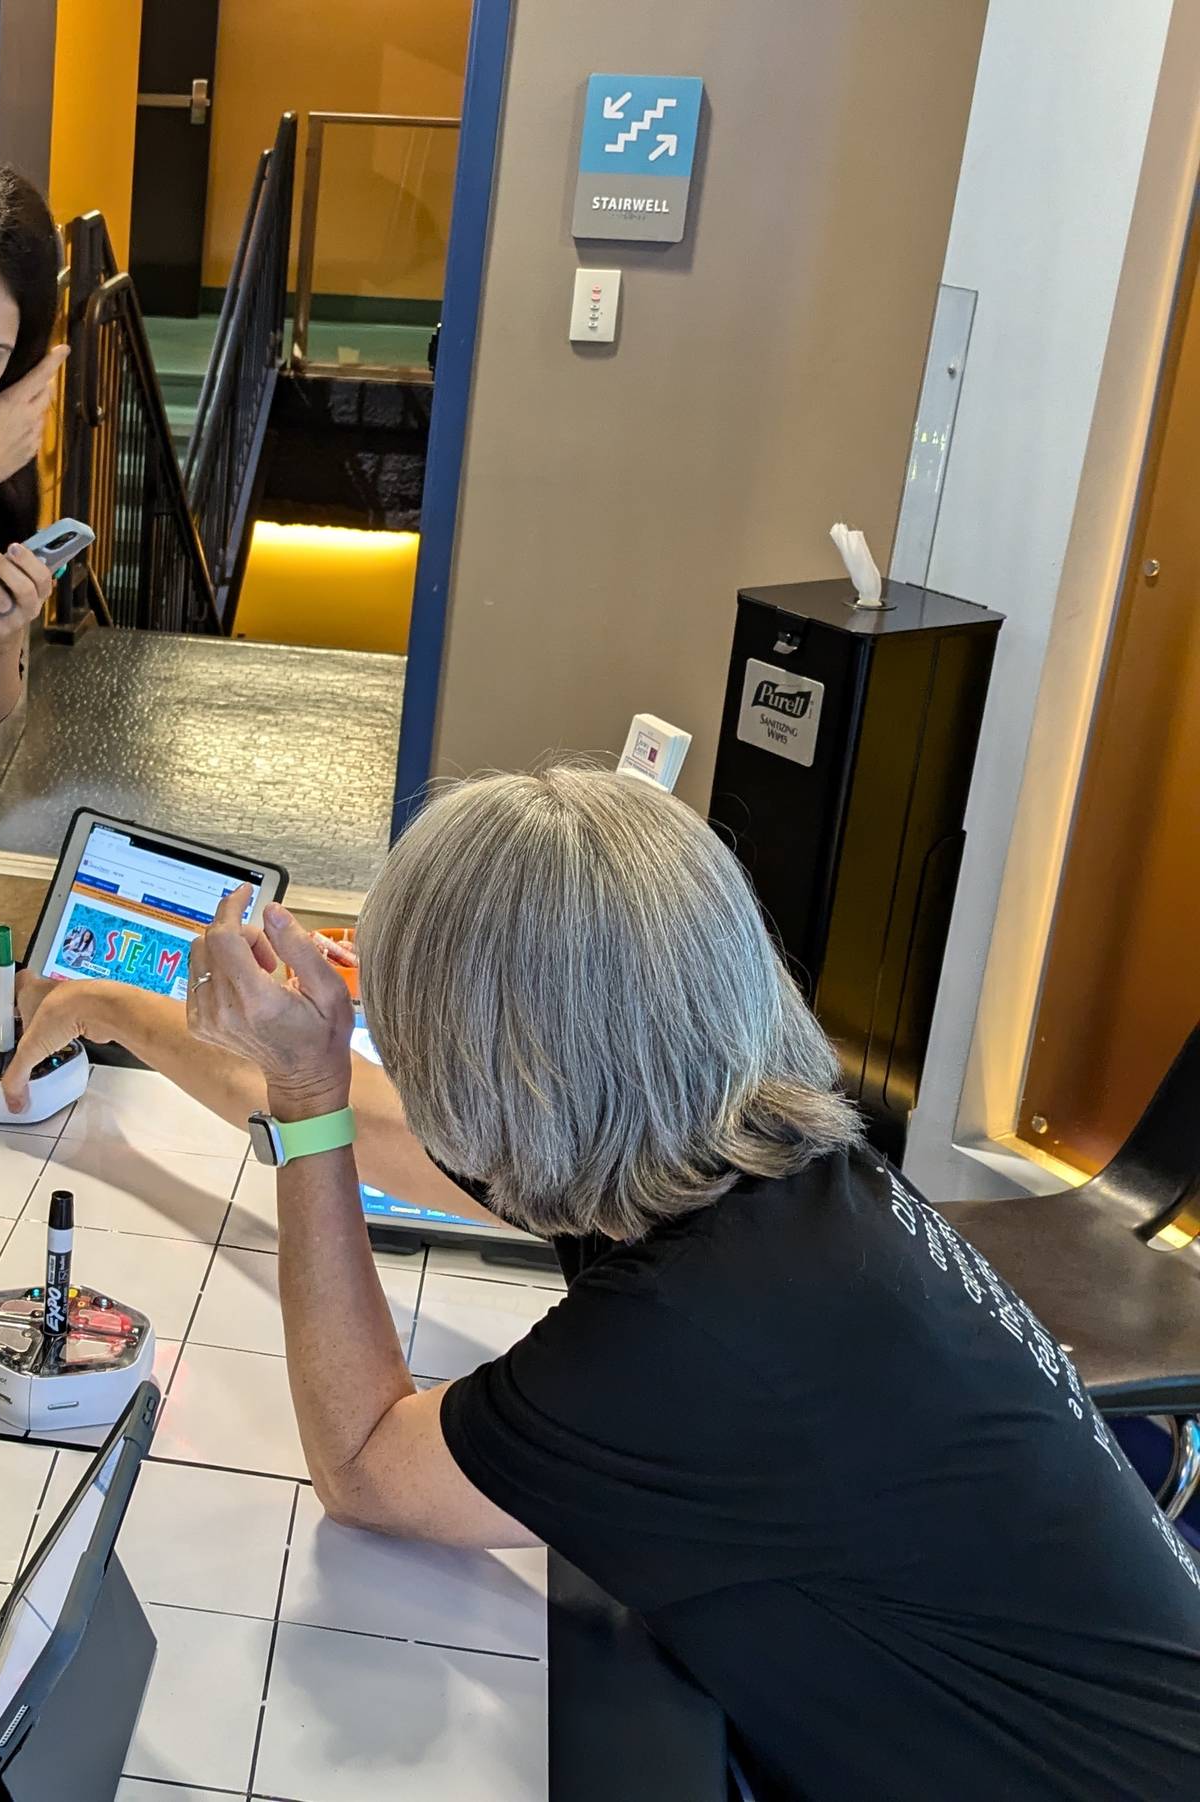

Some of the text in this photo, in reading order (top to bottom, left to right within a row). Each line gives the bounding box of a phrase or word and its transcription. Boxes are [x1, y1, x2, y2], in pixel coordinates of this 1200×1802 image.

[591, 196, 670, 214] STAIRWELL
[758, 683, 805, 717] Purell
[760, 712, 799, 738] SANITIZING
[103, 928, 182, 983] STEAM
[46, 1286, 65, 1332] EXPO
